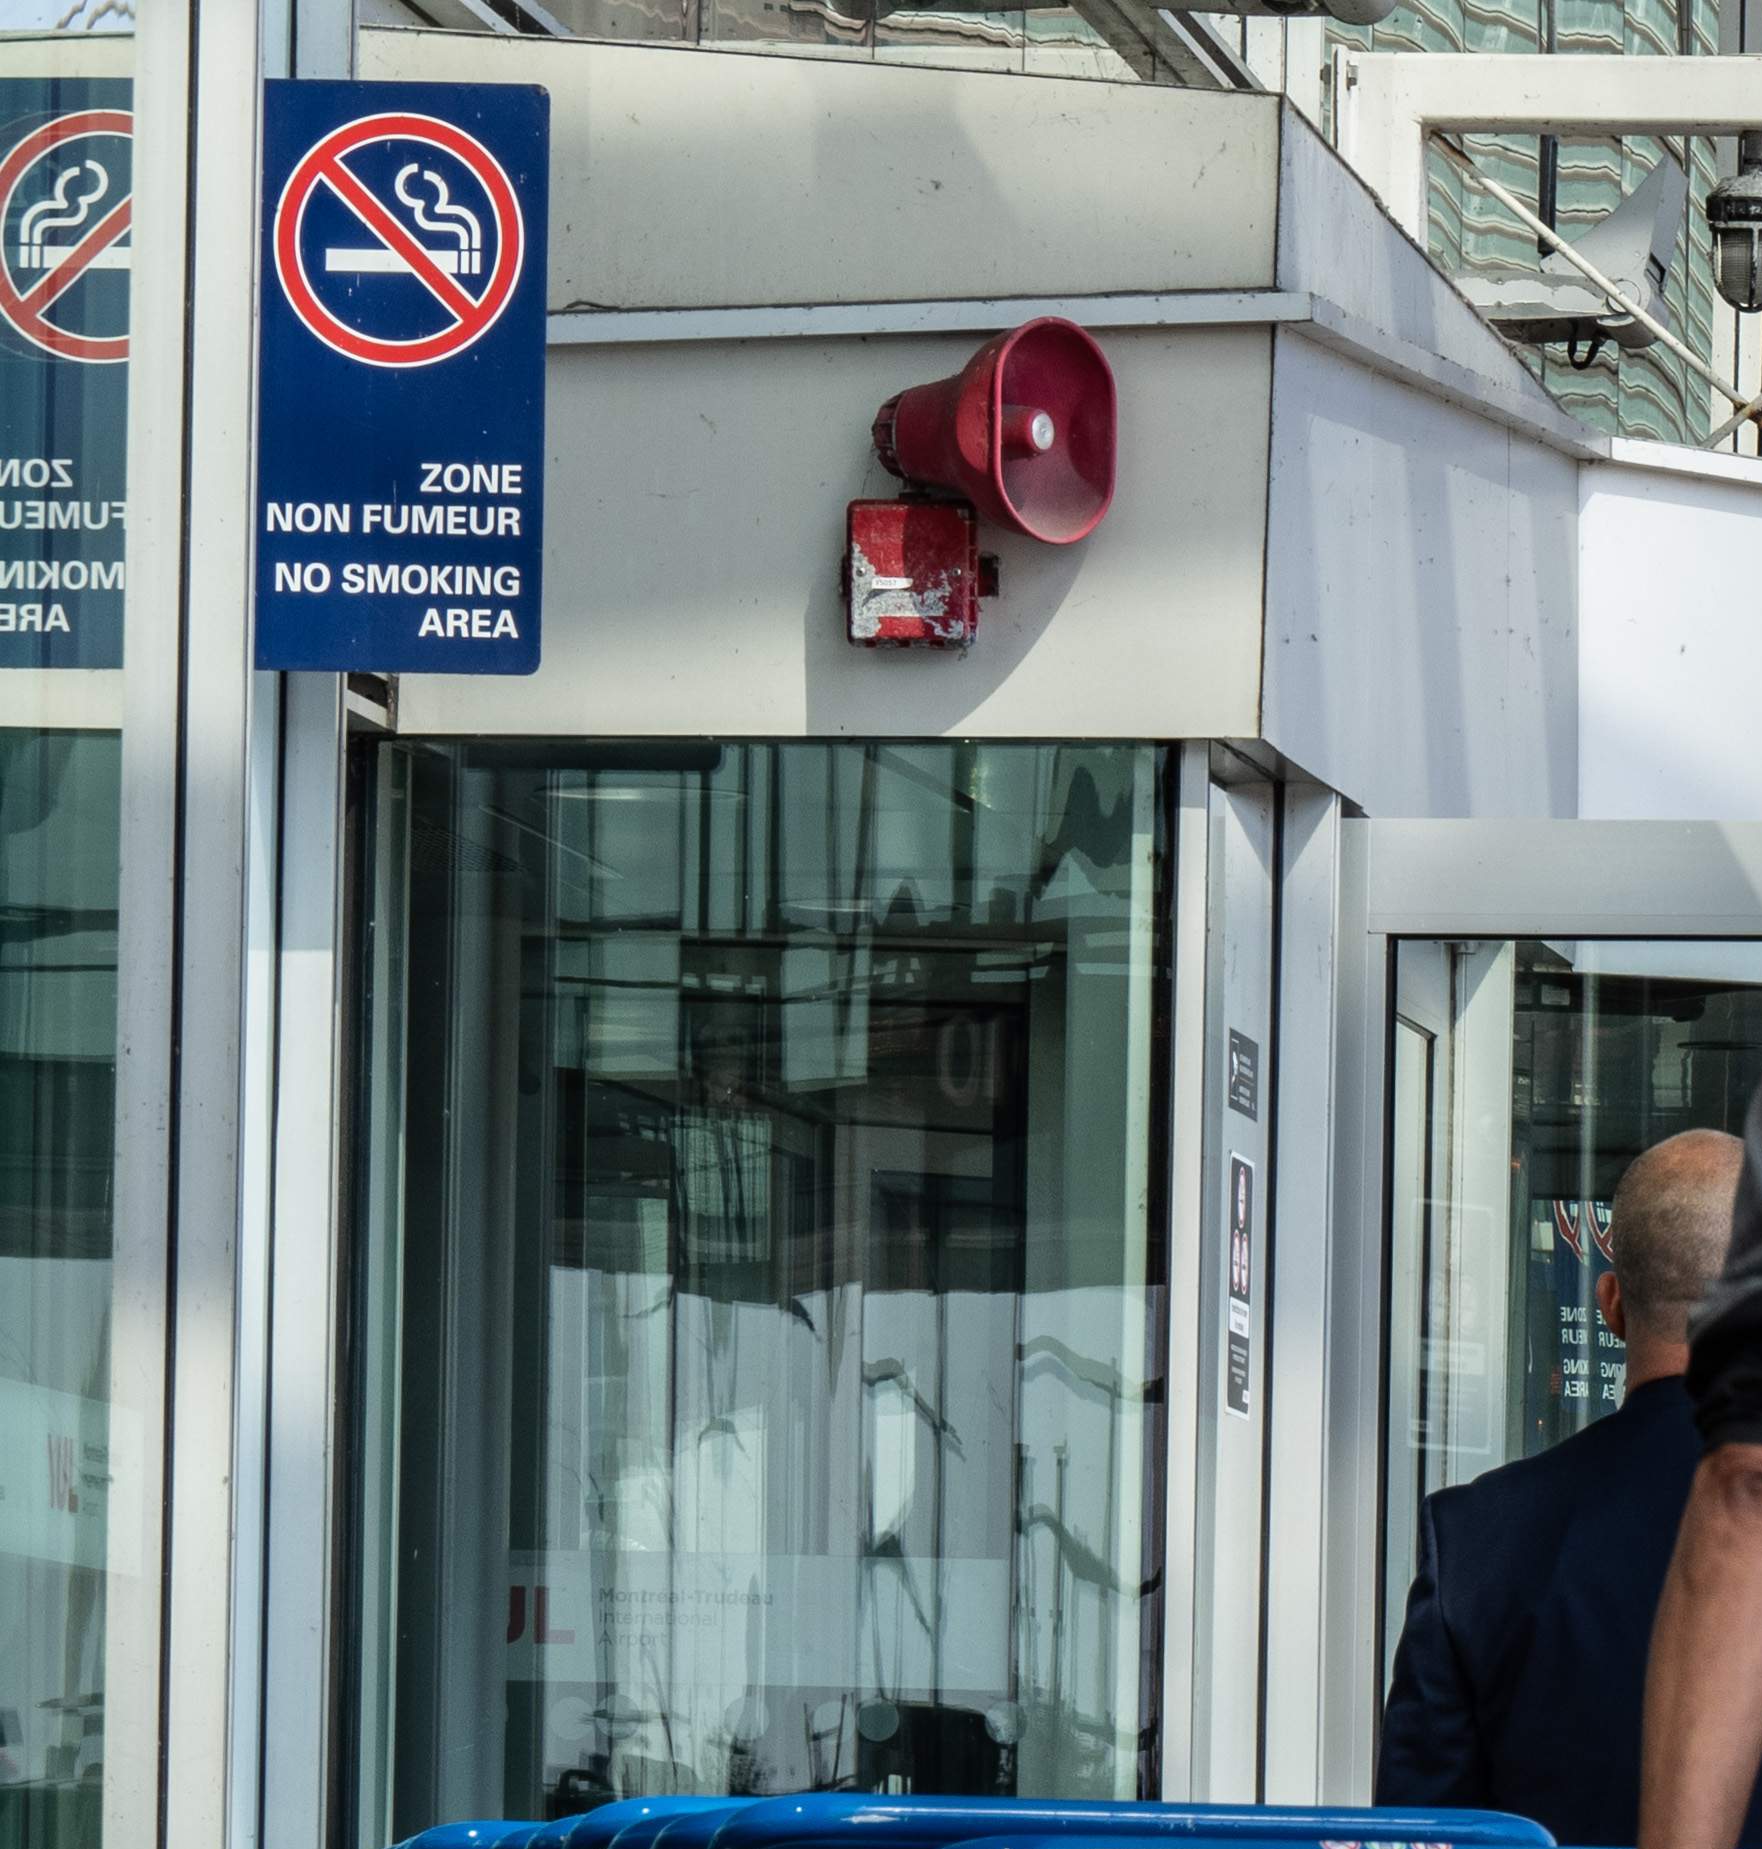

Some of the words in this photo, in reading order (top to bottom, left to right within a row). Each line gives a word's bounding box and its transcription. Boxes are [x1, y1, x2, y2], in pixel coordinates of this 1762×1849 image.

[419, 463, 523, 494] ZONE
[266, 502, 351, 533] NON
[362, 504, 521, 537] FUMEUR
[275, 562, 332, 593] NO
[341, 563, 521, 597] SMOKING
[418, 608, 520, 639] AREA
